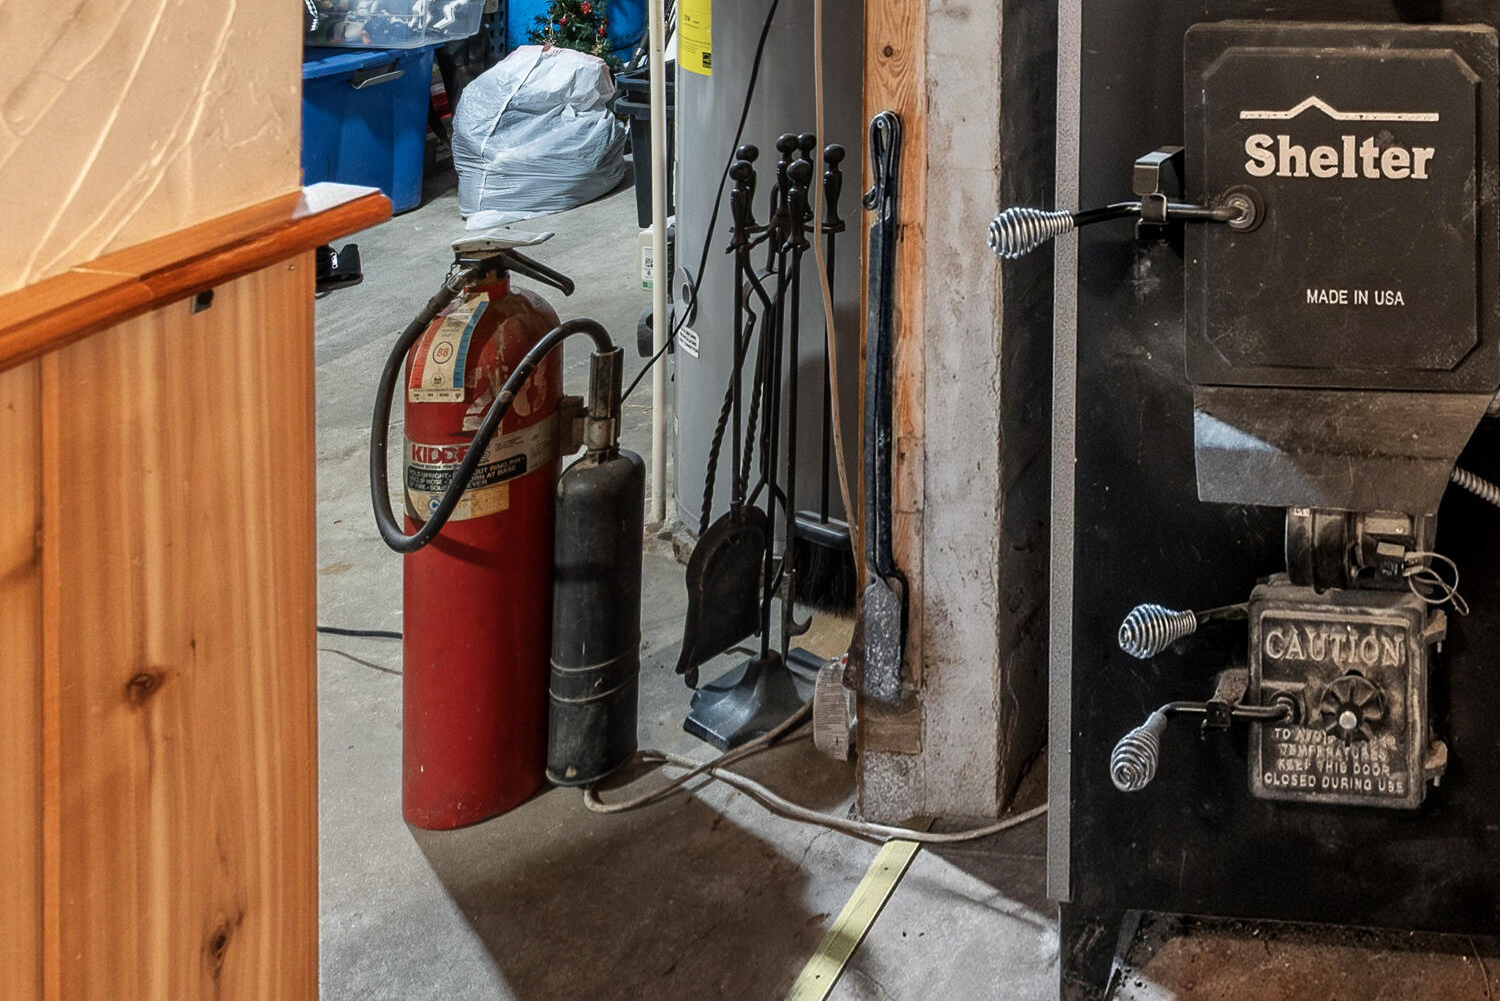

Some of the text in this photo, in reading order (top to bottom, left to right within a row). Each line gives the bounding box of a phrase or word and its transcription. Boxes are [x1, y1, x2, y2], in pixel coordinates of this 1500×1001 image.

[1244, 133, 1436, 180] Shelter
[1306, 288, 1405, 307] MADE IN USA
[436, 347, 449, 358] 88
[1266, 628, 1406, 667] CAUTION
[1274, 727, 1291, 740] TO
[1278, 758, 1391, 777] KEEP THIS DOOR
[1264, 772, 1405, 794] CLOSED DURING USE
